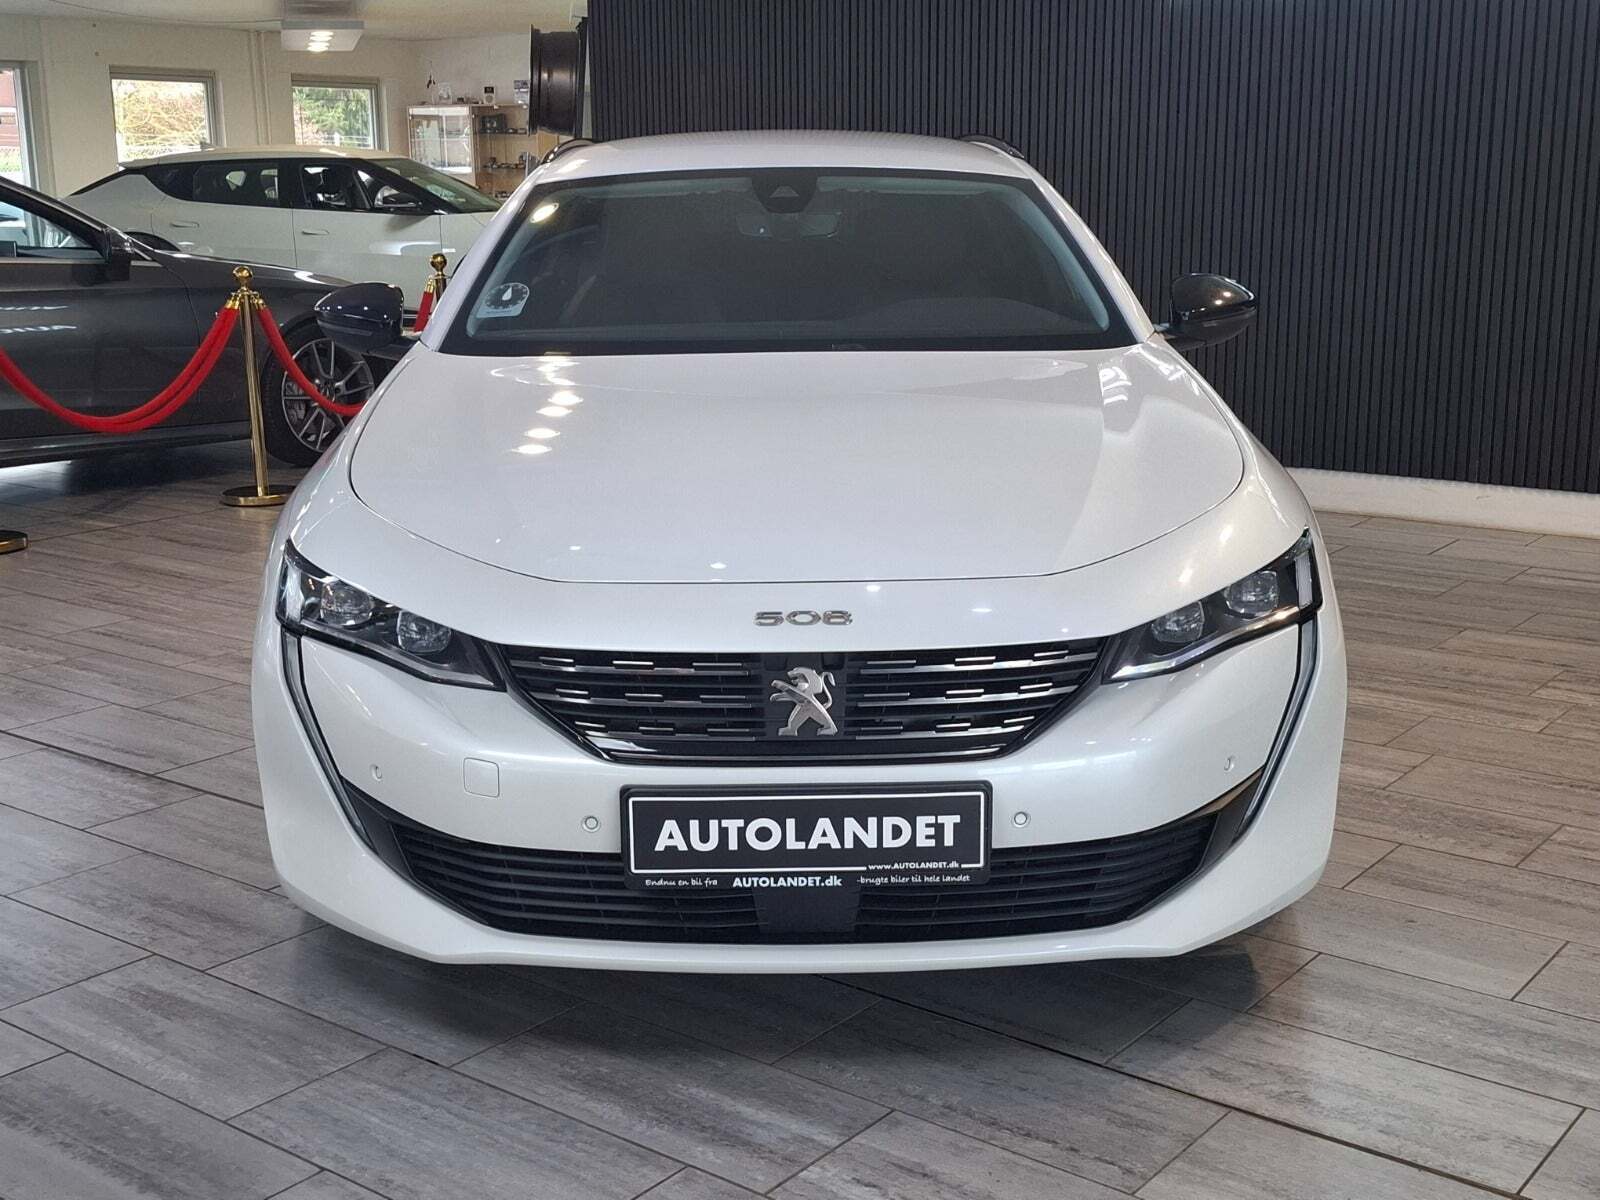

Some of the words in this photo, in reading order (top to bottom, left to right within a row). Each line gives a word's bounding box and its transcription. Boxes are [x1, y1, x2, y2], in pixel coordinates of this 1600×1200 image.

[754, 610, 853, 627] 508
[654, 814, 961, 852] AUTOLANDET
[868, 862, 959, 871] www.AUTOLANDET.dk
[691, 877, 702, 886] bil
[704, 878, 718, 888] fra
[732, 875, 842, 888] AUTOLANDET.dk
[890, 875, 909, 883] biler
[911, 874, 921, 882] til
[924, 874, 941, 882] hele
[942, 873, 970, 882] landet
